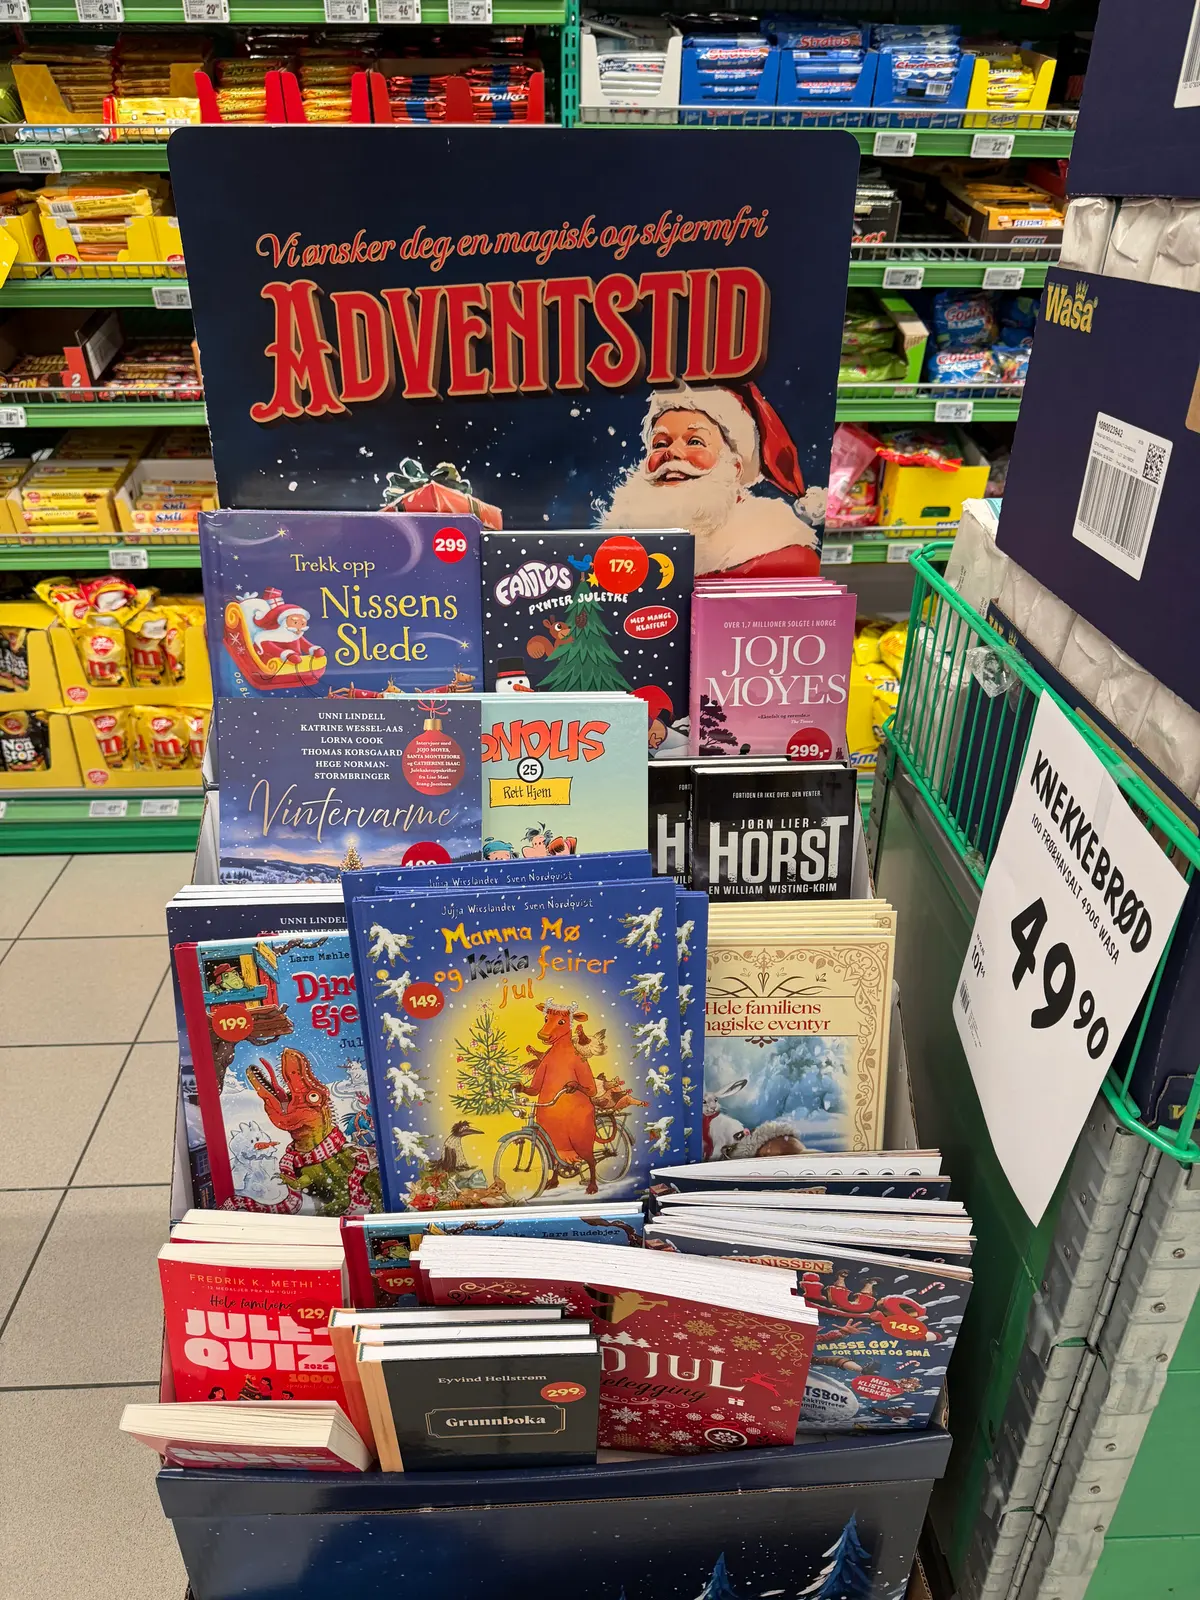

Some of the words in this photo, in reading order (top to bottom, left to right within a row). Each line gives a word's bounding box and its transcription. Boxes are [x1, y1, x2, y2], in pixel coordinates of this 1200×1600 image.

[800, 35, 850, 48] Stratos
[479, 91, 527, 102] Troika
[256, 231, 300, 269] Vi
[301, 228, 397, 267] ønsker
[399, 225, 455, 272] deg
[457, 234, 494, 255] en
[492, 215, 600, 266] magisk
[599, 225, 641, 261] og
[640, 205, 769, 259] skjermfri
[1045, 282, 1094, 334] Wasa
[249, 266, 771, 424] ADVENTSTID
[434, 537, 468, 554] 299
[289, 553, 341, 573] Trekk
[343, 558, 376, 579] opp
[495, 561, 573, 607] FANTUS
[319, 584, 460, 621] Nissens
[528, 594, 574, 616] PYNTER
[630, 614, 646, 625] MED
[723, 621, 741, 629] OVER
[752, 620, 787, 629] MILLIONER
[787, 619, 811, 628] SOLGTE
[815, 619, 837, 628] NORGE
[334, 622, 429, 668] Slede
[721, 634, 827, 679] JOJO
[704, 673, 847, 708] MOYES
[318, 711, 344, 721] UNNI
[344, 711, 387, 721] LINDELL
[300, 723, 344, 733] KATRINE
[345, 723, 404, 734] WESSEL-AAS
[320, 735, 354, 745] LORNA
[355, 735, 384, 745] COOK
[301, 747, 343, 757] THOMAS
[343, 748, 404, 757] KORSGAARD
[789, 743, 830, 758] 299,-
[315, 759, 342, 769] HEGE
[343, 759, 390, 769] NORMAN-
[522, 763, 538, 776] 25
[313, 771, 391, 781] STORMBRINGER
[502, 785, 524, 799] Rett
[526, 784, 552, 799] Hjem
[764, 791, 776, 799] IKKE
[248, 778, 460, 844] Vintervarme
[740, 818, 774, 830] JØRN
[781, 817, 810, 829] LIER
[709, 815, 849, 884] HORST
[1029, 749, 1153, 953] KNEKKEBRØD
[708, 885, 720, 895] EN
[723, 884, 764, 895] WILLIAM
[769, 882, 838, 895] WISTING-KRIM
[1030, 812, 1043, 835] 100
[1098, 923, 1121, 966] WASA
[523, 900, 546, 911] Sven
[546, 897, 595, 911] Nordquist
[279, 916, 308, 926] UNNI
[309, 916, 348, 925] LINDEL
[440, 921, 534, 955] Mamma
[539, 916, 582, 943] Mø
[288, 954, 316, 964] Lars
[318, 951, 350, 961] Mæhle
[1010, 896, 1077, 1030] 49
[433, 967, 465, 994] og
[466, 946, 530, 982] Kråka
[535, 944, 617, 983] feirer
[498, 977, 536, 1010] jul
[705, 1000, 742, 1015] Hele
[745, 999, 823, 1015] familiens
[310, 1002, 360, 1038] gje
[767, 1018, 832, 1034] eventyr
[338, 1037, 364, 1050] Jul
[541, 1230, 569, 1239] Lars
[572, 1228, 621, 1238] Rudebjer
[188, 1272, 246, 1287] FREDRIK
[251, 1279, 266, 1288] K.
[270, 1279, 314, 1289] METHI
[209, 1294, 237, 1310] Hele
[816, 1340, 866, 1352] MASSE
[868, 1339, 899, 1350] GØY
[888, 1349, 904, 1357] OG
[904, 1348, 931, 1358] SMÅ
[184, 1337, 337, 1373] QUIZ
[303, 1363, 330, 1371] 2026
[643, 1350, 747, 1392] JUL
[287, 1373, 335, 1384] 1000
[437, 1376, 483, 1385] Eyvind
[484, 1373, 548, 1383] Hellstrøm
[869, 1376, 890, 1387] MED
[445, 1414, 547, 1428] Grunnboka
